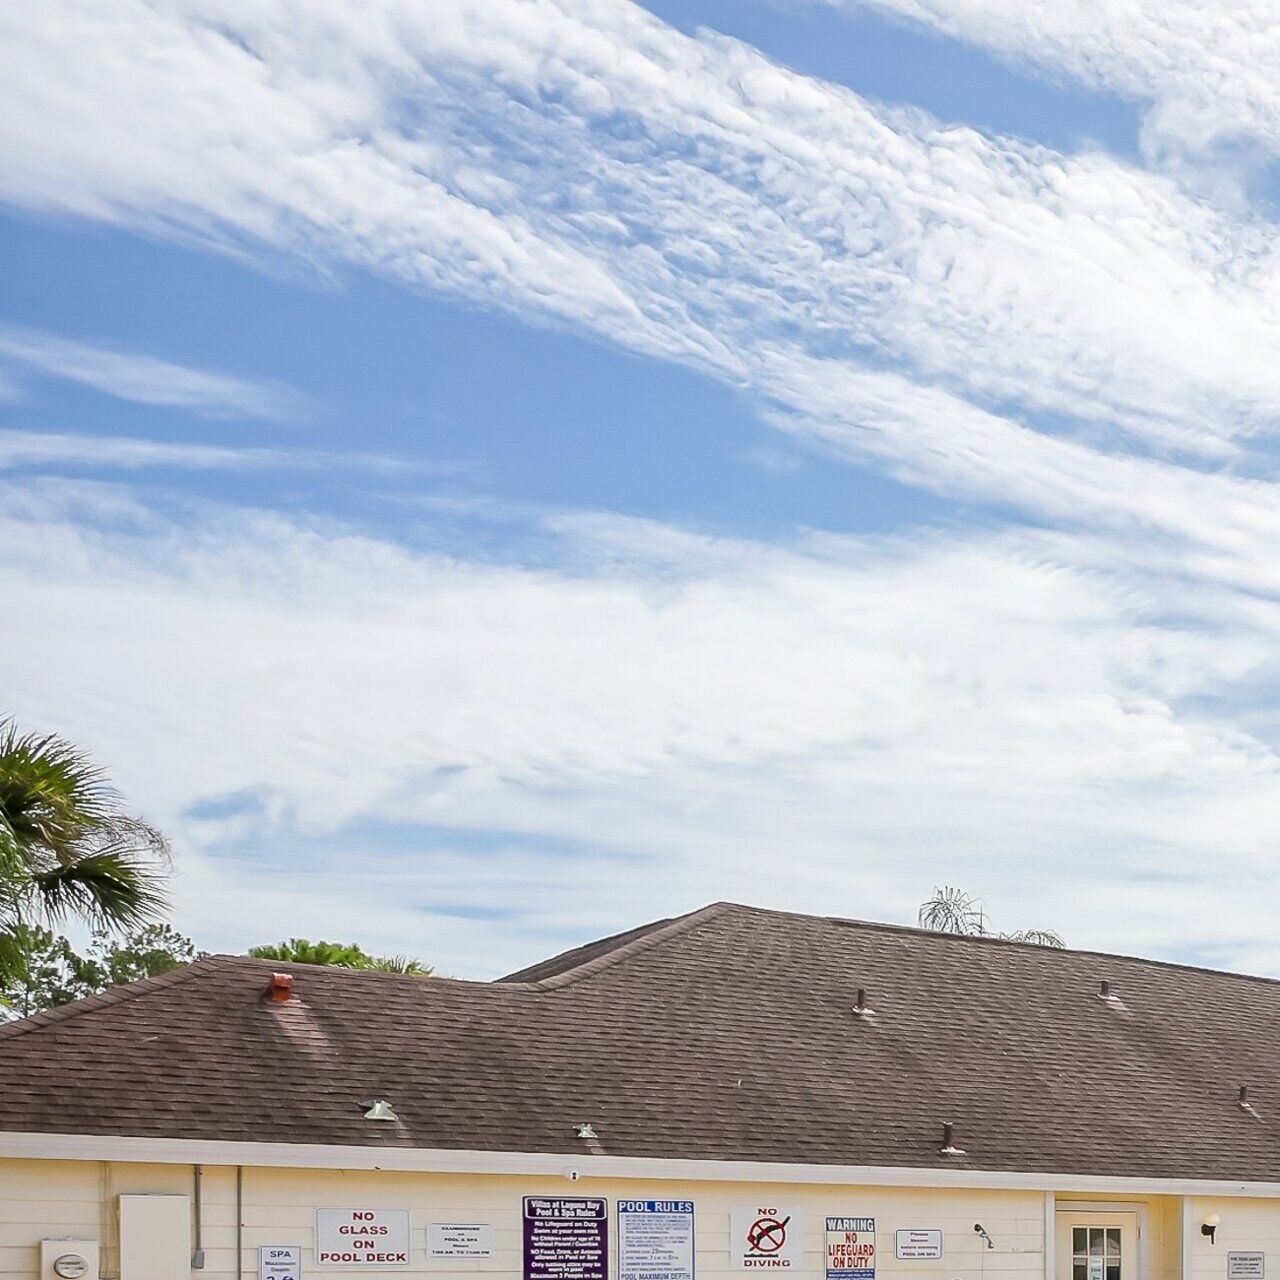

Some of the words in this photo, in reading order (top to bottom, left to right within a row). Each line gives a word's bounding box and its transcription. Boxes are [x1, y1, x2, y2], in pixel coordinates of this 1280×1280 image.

[561, 1201, 585, 1210] Laguna
[587, 1202, 600, 1210] Bay
[619, 1202, 652, 1211] POOL
[655, 1202, 692, 1211] RULES
[353, 1212, 374, 1221] NO
[561, 1209, 575, 1217] Spa
[827, 1218, 874, 1231] WARNING
[339, 1225, 388, 1235] GLASS
[845, 1233, 857, 1243] NO
[353, 1240, 374, 1249] ON
[270, 1250, 292, 1258] SPA
[828, 1244, 874, 1257] LIFEGUARD
[320, 1253, 361, 1262] POOL
[366, 1253, 406, 1262] DECK
[833, 1257, 845, 1268] ON
[847, 1257, 869, 1268] DUTY
